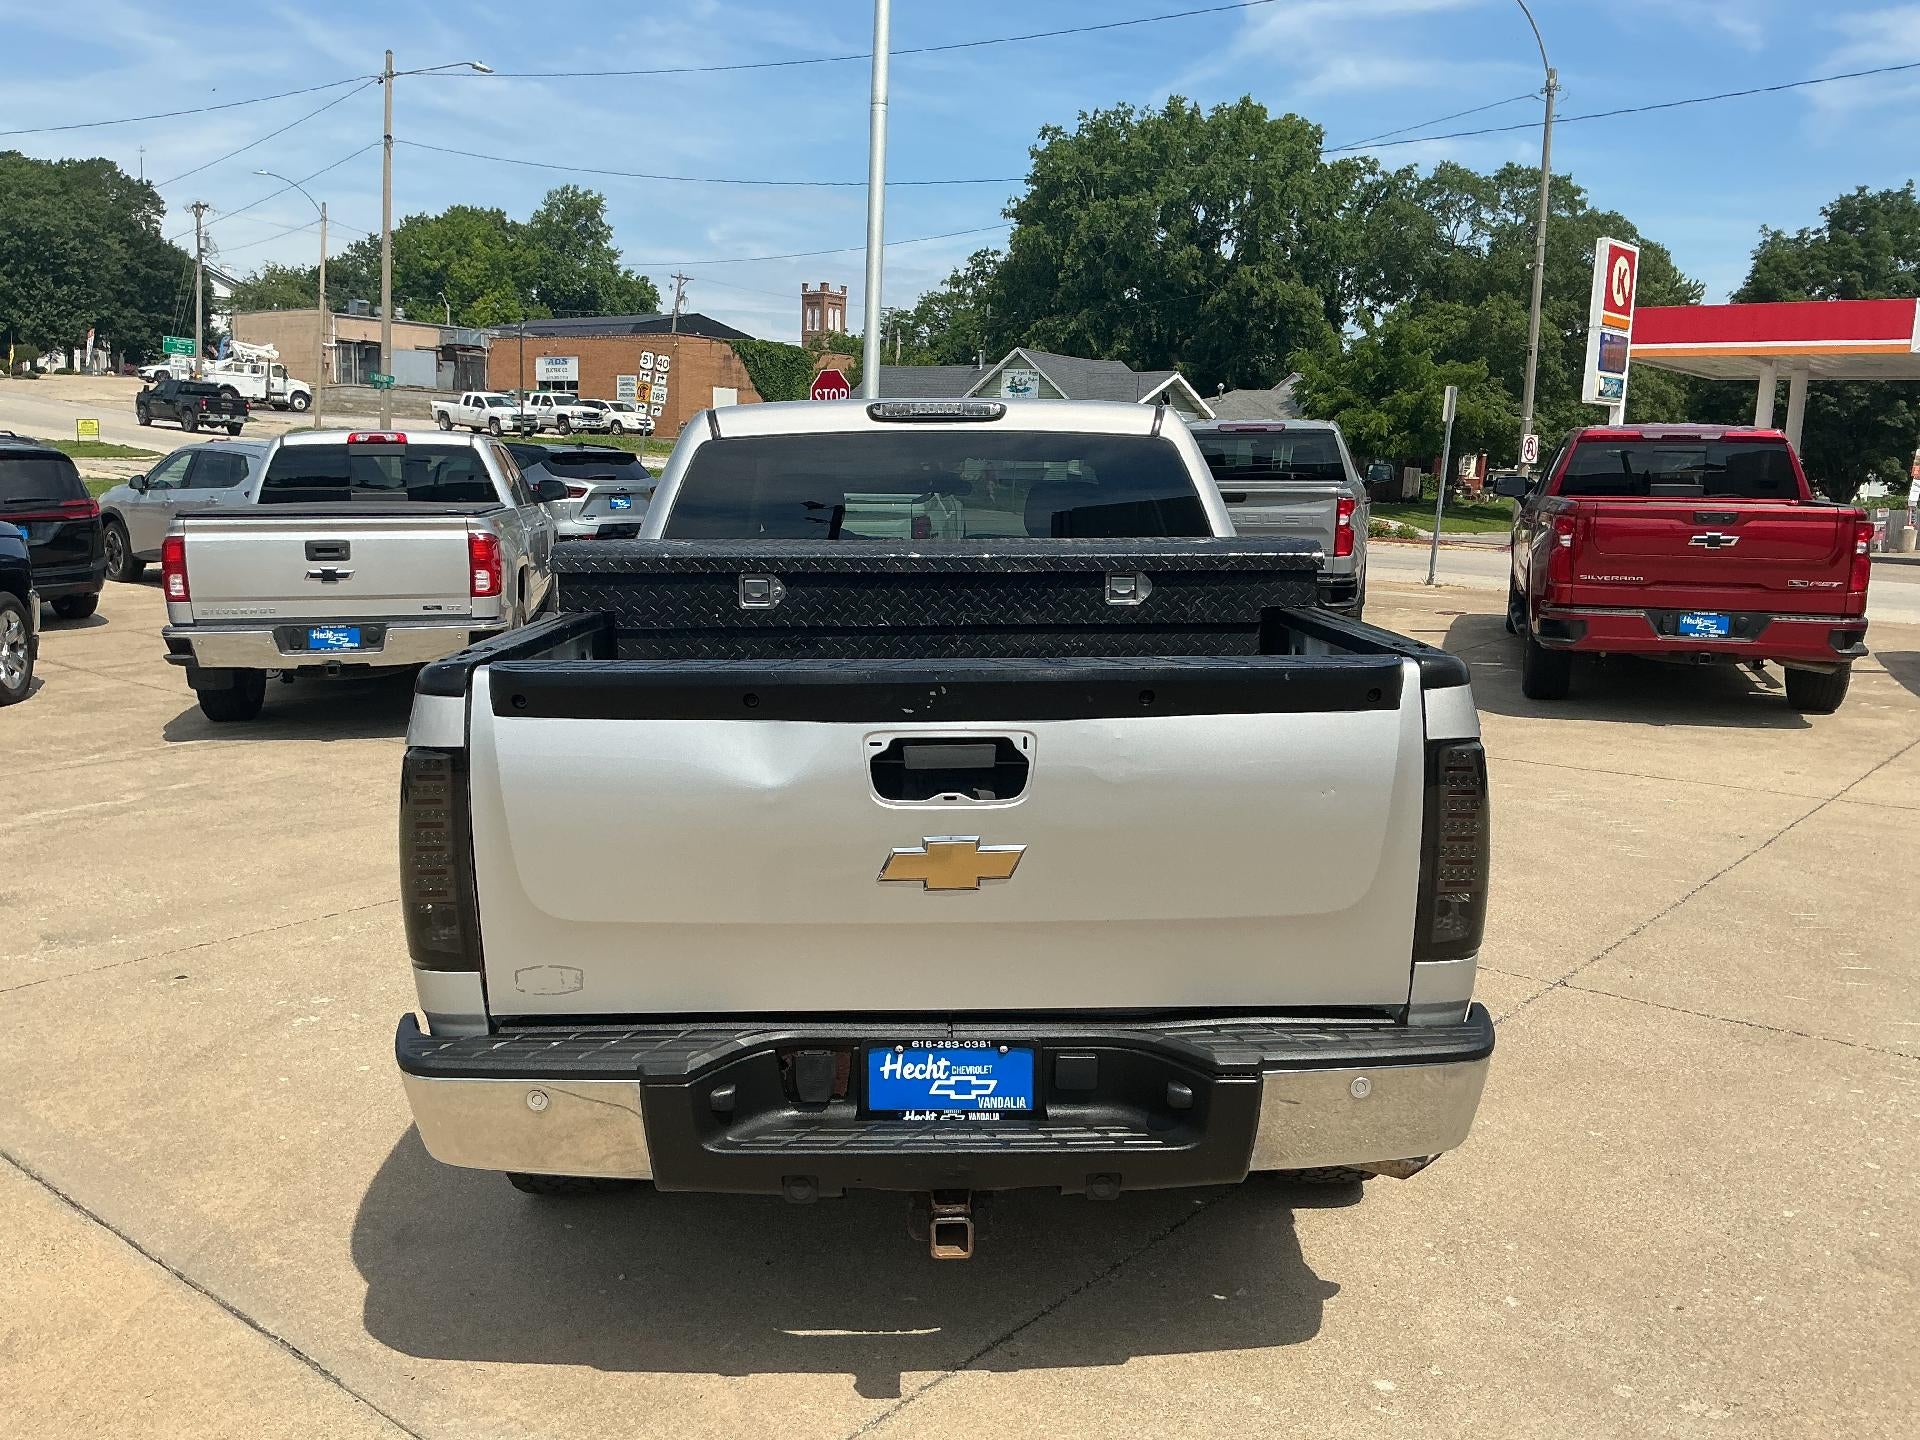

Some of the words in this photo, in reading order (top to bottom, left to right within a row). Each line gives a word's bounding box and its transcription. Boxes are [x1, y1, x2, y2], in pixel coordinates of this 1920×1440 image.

[643, 355, 652, 365] 51
[657, 359, 669, 369] 40
[652, 391, 665, 402] 185
[911, 1040, 991, 1049] 618-283-0381
[880, 1053, 950, 1080] Hecht
[951, 1065, 993, 1075] CHEVROLET
[978, 1097, 1027, 1109] VANDALIA
[967, 1111, 1000, 1121] VANDALIA
